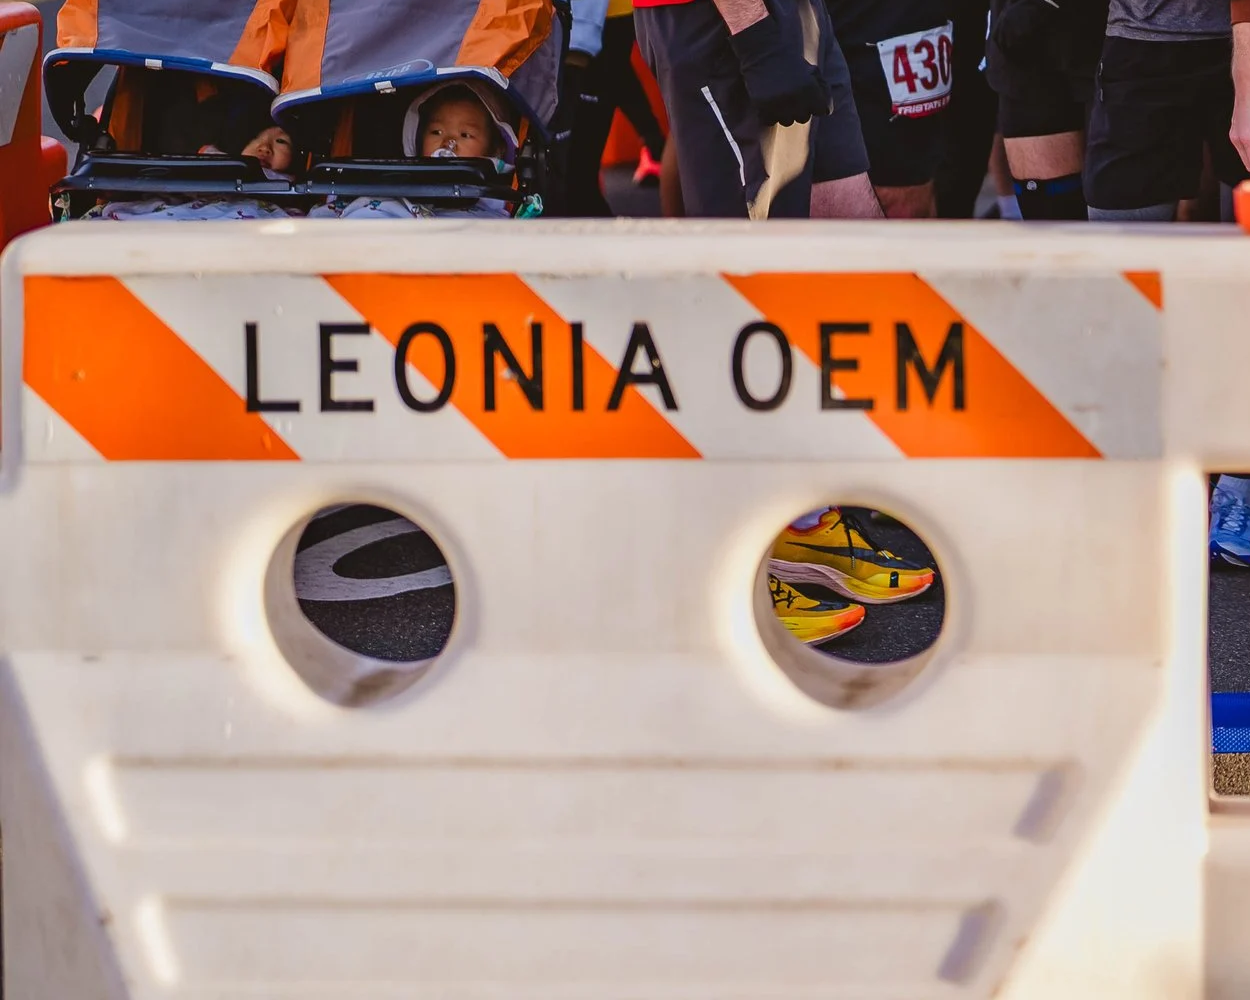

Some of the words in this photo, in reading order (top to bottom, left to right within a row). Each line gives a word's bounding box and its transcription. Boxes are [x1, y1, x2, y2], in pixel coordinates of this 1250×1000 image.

[892, 33, 952, 95] 430
[245, 322, 678, 413] LEONIA
[732, 321, 968, 412] OEM
